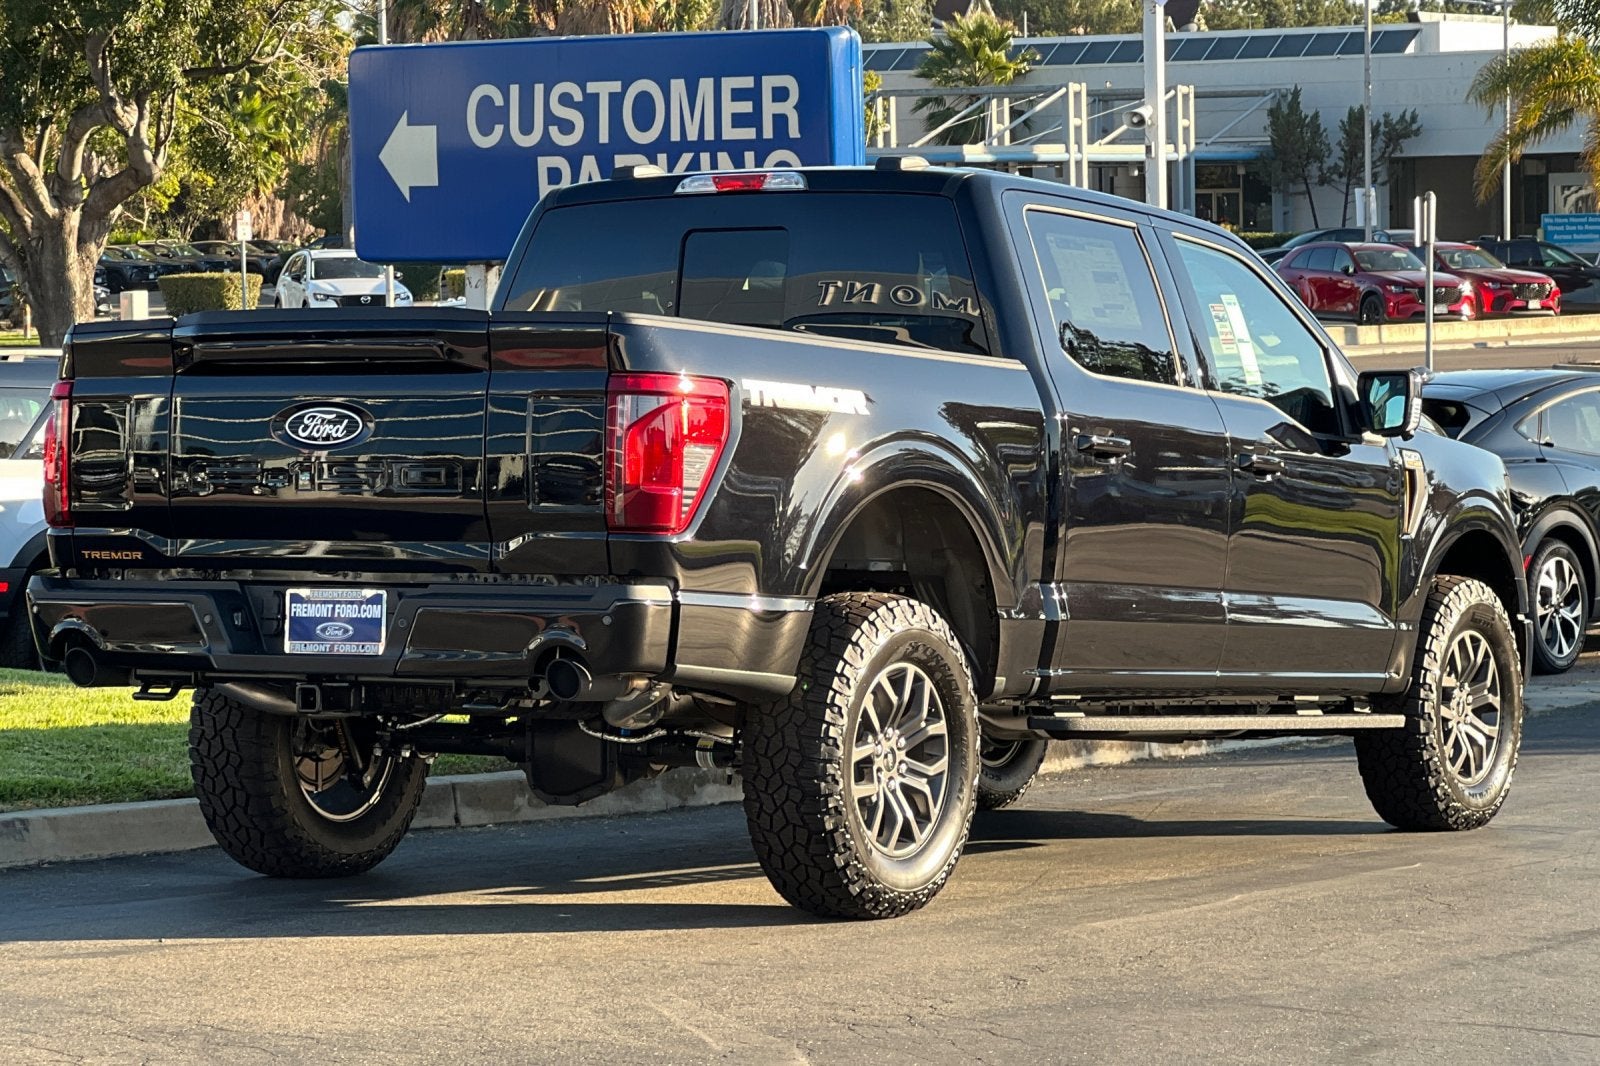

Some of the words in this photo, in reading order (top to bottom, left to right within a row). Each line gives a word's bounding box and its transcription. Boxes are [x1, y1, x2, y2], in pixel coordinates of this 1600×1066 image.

[467, 75, 801, 149] CUSTOMER
[741, 378, 870, 415] TRMOR
[298, 412, 349, 438] Ford
[81, 550, 143, 560] TREMOR
[291, 603, 333, 618] FREMONT
[334, 604, 382, 619] FORD.COM
[290, 643, 331, 652] FREMONT
